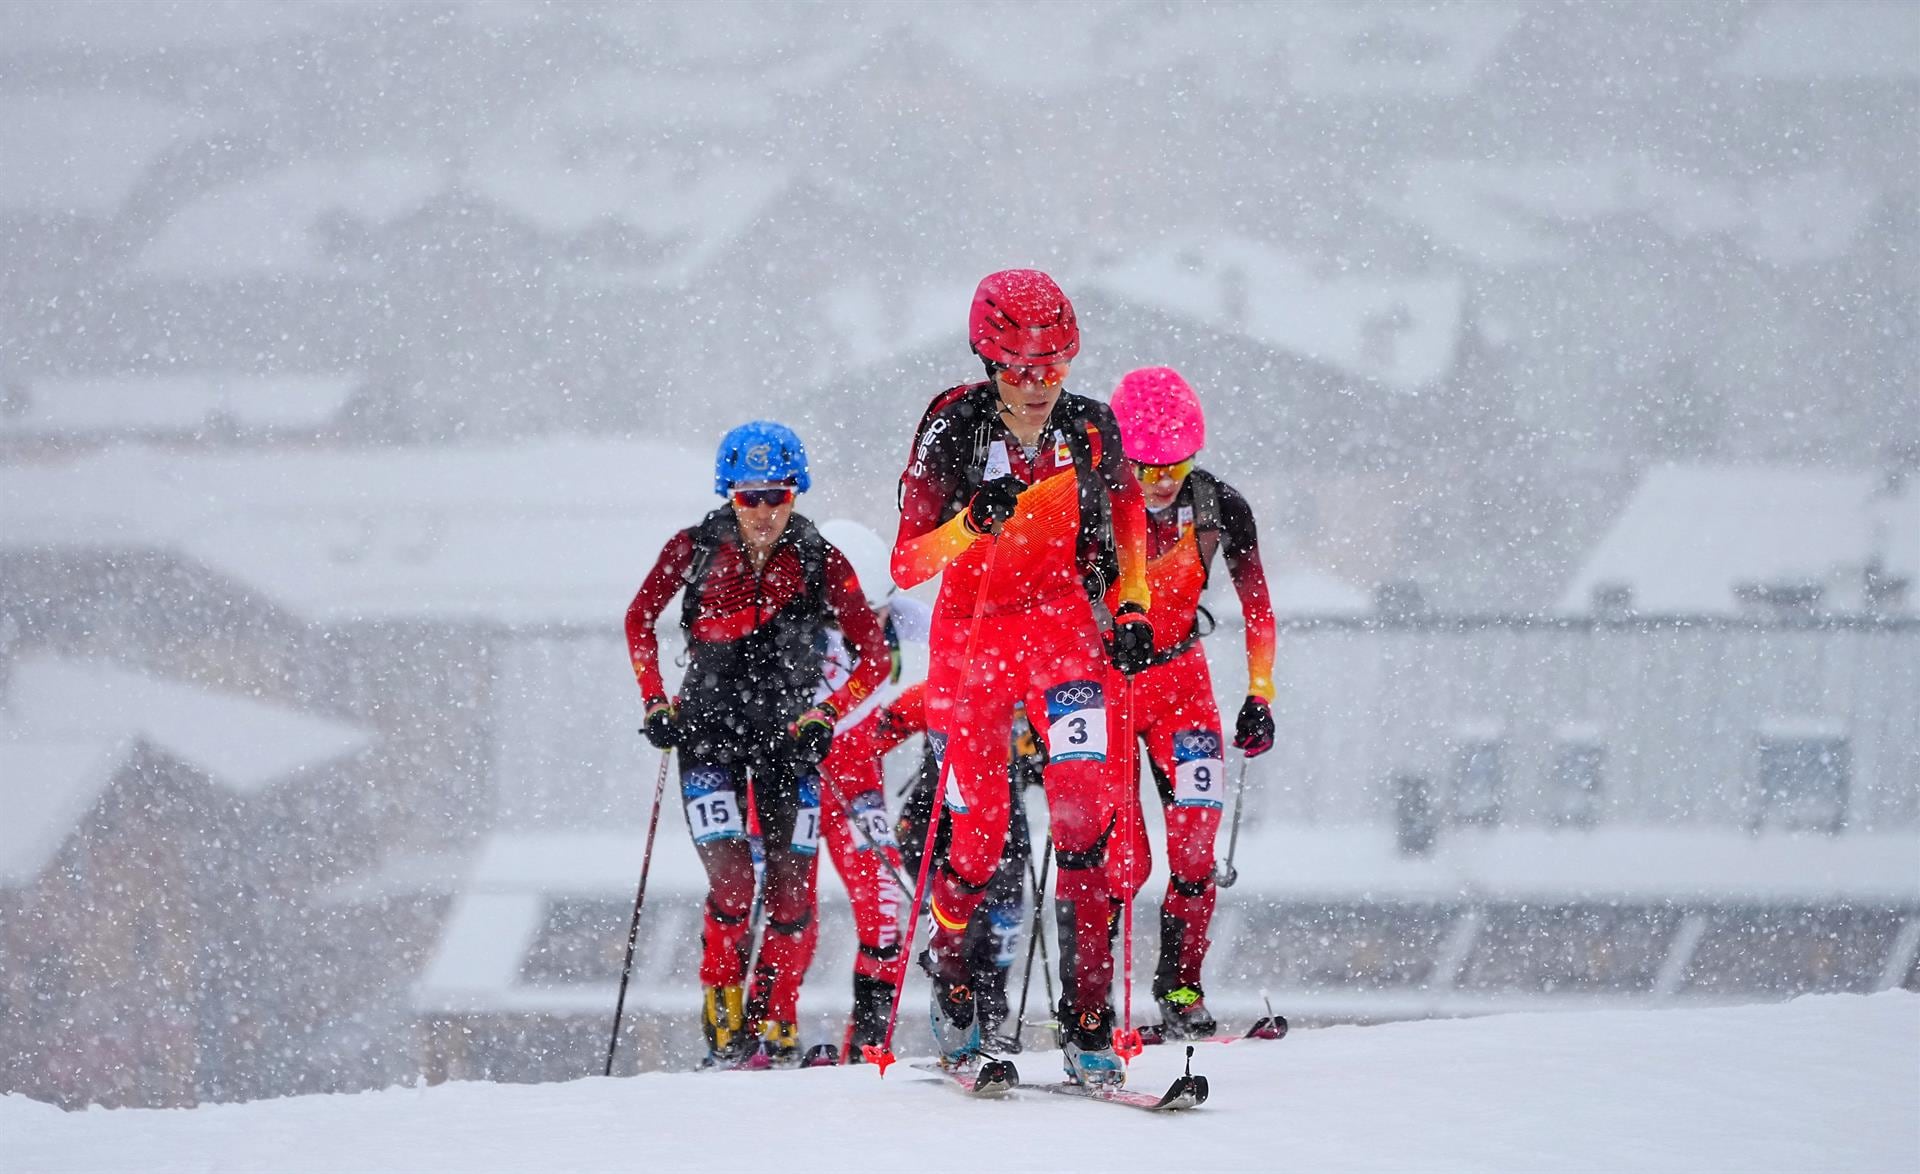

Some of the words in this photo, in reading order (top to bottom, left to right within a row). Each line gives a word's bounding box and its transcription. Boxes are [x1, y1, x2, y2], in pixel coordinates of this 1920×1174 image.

[1068, 717, 1088, 745] 3
[1194, 766, 1211, 792] 9
[696, 800, 729, 828] 15
[807, 814, 820, 839] 1
